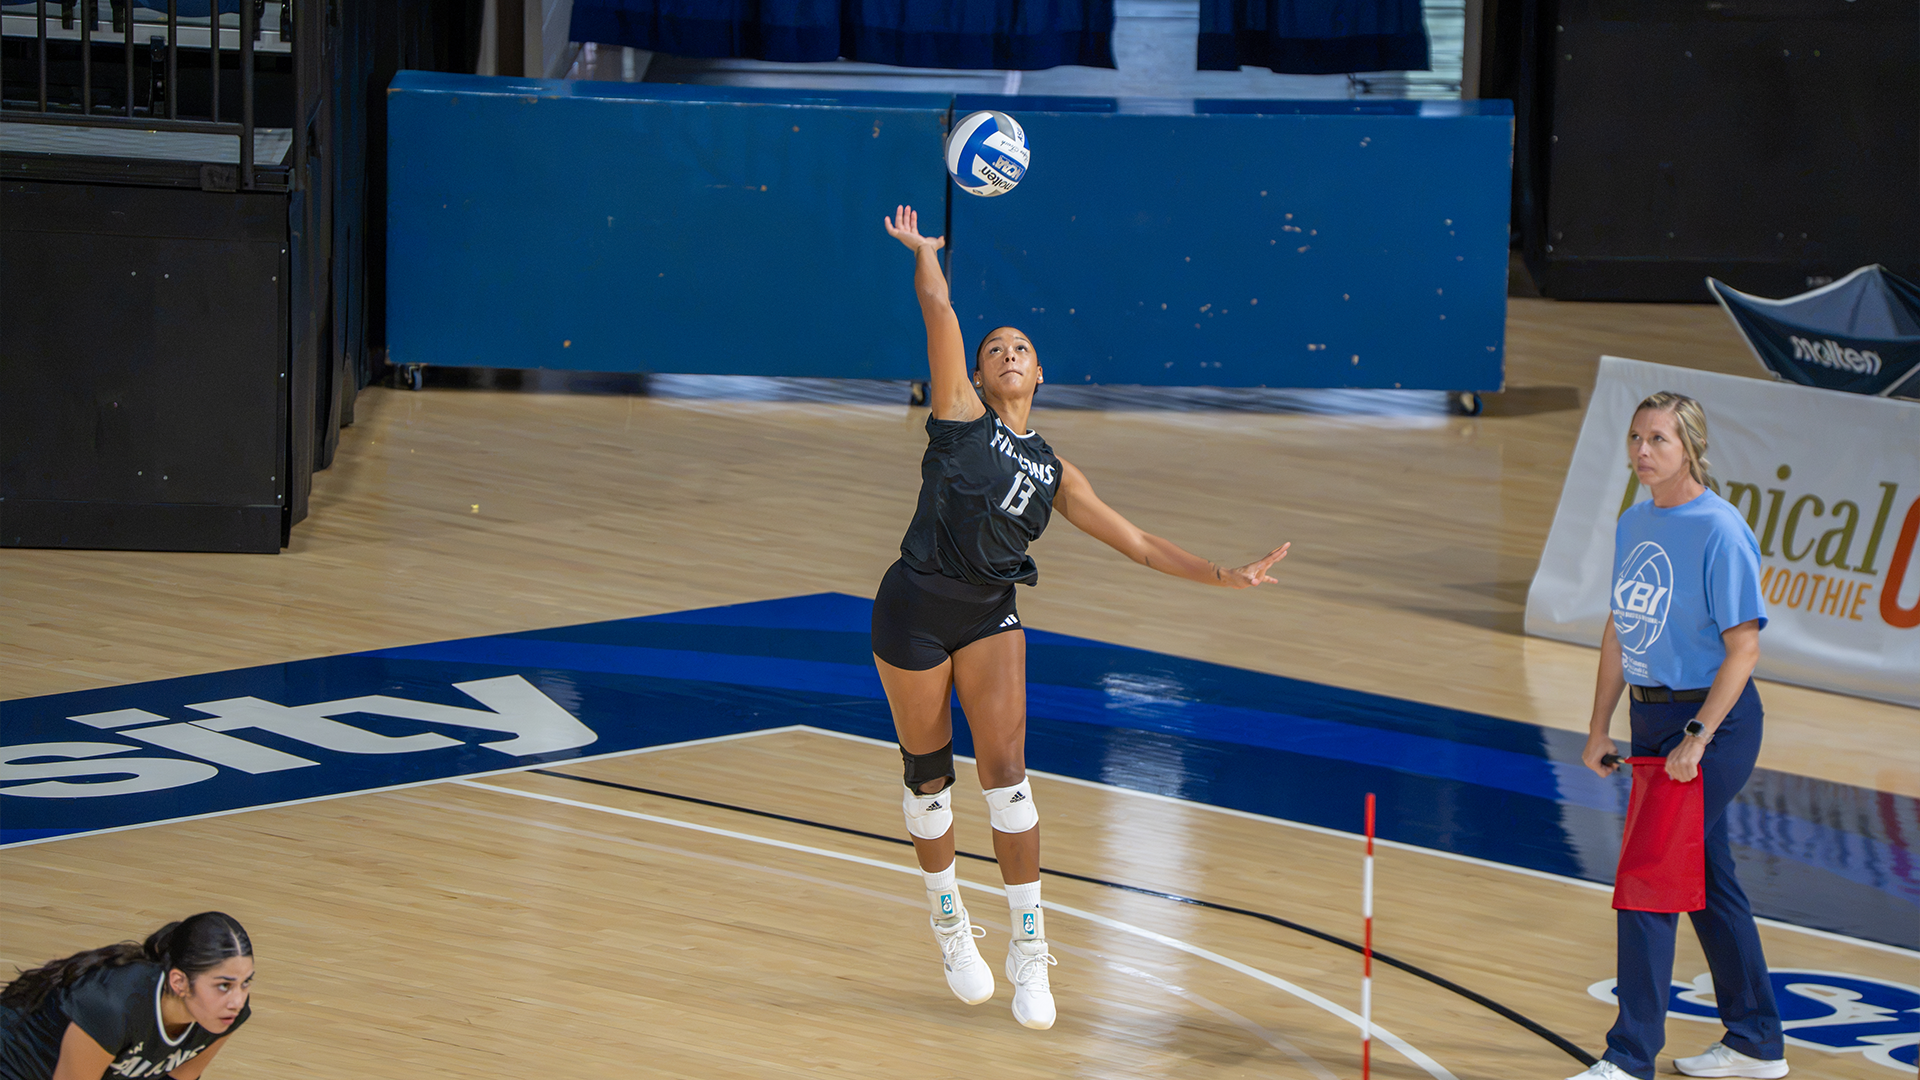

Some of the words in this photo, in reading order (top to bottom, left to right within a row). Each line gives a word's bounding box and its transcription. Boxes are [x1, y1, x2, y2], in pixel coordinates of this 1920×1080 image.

[994, 155, 1021, 181] NCAA
[1790, 335, 1882, 376] molten
[990, 429, 1056, 486] FACONS
[1000, 470, 1037, 517] 13
[1614, 578, 1668, 616] KBI
[1760, 564, 1873, 621] MOOTHIE
[0, 674, 598, 798] sity
